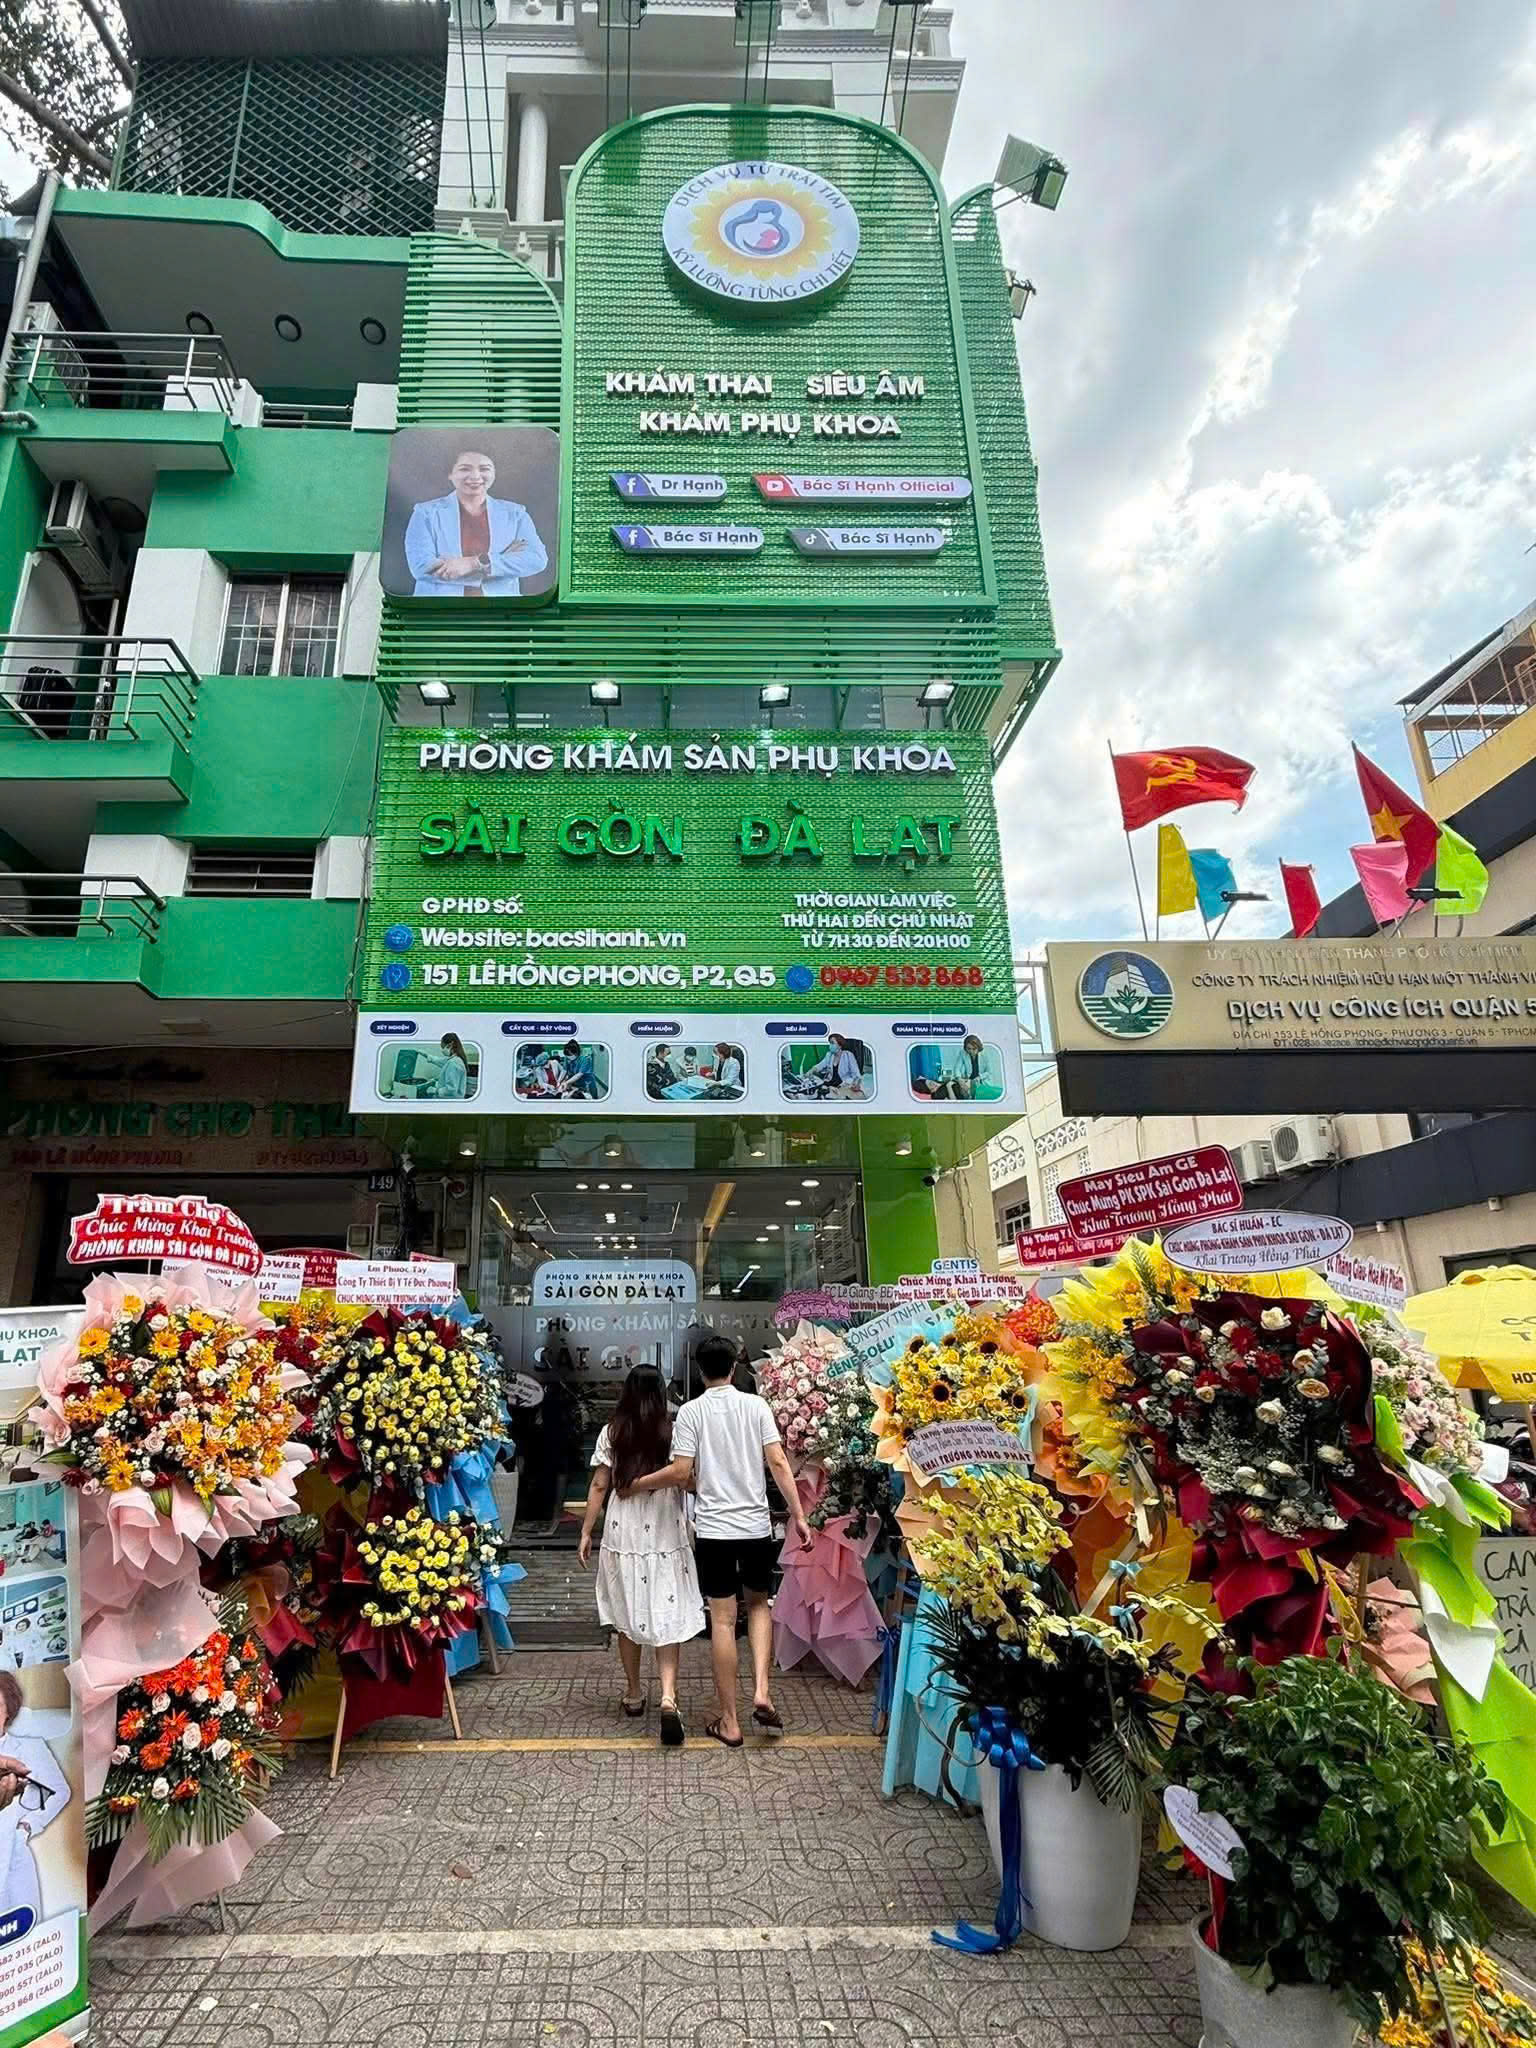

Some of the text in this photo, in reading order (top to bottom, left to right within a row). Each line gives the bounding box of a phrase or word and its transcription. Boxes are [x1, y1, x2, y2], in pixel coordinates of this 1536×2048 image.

[675, 175, 714, 208] DỊCH
[819, 186, 847, 209] TIM
[799, 274, 829, 293] CHI
[825, 250, 854, 279] TIẾT
[606, 365, 926, 396] KHÁM THAI SIÊU ÂM
[639, 405, 902, 443] KHÁM PHỤ KHOA
[661, 478, 724, 496] Dr Hạnh
[803, 477, 956, 496] Bác Sĩ Hạnh Official
[663, 528, 760, 548] Bác Sĩ Hạnh
[841, 530, 936, 549] Bác Sĩ Hạnh
[419, 731, 957, 778] PHÒNG KHÁM SẢN PHỤ KHOA
[418, 798, 962, 873] SÀI GÒN ĐÀ LẠT
[422, 893, 524, 915] GPHĐ số:
[782, 908, 975, 930] THỨ HAI ĐẾN CHỦ NHẬT
[526, 927, 686, 948] bacsihanh.vn
[801, 931, 824, 948] TỪ
[909, 934, 971, 948] 20H00
[421, 964, 458, 986] 151
[819, 966, 984, 987] 0967 533 868
[1191, 969, 1520, 988] CÔNG TY TRÁCH NHIỆM HỮU HẠN MỘT THÀNH
[1228, 994, 1536, 1024] DỊCH VỤ CÔNG ÍCH QUẬN 5
[1274, 1030, 1293, 1039] 153
[1310, 1027, 1342, 1039] HỒNG
[1344, 1028, 1383, 1038] PHONG
[1442, 1029, 1448, 1037] 3
[1488, 1028, 1495, 1037] 5
[164, 1100, 254, 1140] CHO
[1175, 1155, 1199, 1171] GE
[369, 1175, 395, 1191] 149
[1118, 1187, 1136, 1206] PK
[1133, 1182, 1158, 1203] SPK
[1270, 1215, 1283, 1228] EC
[86, 1215, 260, 1254] Chúc Mừng Khai Trương
[76, 1233, 250, 1270] PHÒNG KHÁM SÀI GÒN ĐÀ LẠT
[933, 1259, 978, 1271] GENTIS
[585, 1271, 613, 1281] KHÁM
[616, 1271, 635, 1281] SẢN
[638, 1273, 656, 1282] PHỤ
[659, 1273, 685, 1281] KHOA
[899, 1274, 1017, 1288] Chúc Mừng Khai Trương
[544, 1281, 686, 1302] SÀI GÒN ĐÀ LẠT
[996, 1286, 1024, 1297] CN HCM
[535, 1312, 607, 1333] PHÒNG
[611, 1311, 669, 1331] KHÁM
[891, 1302, 928, 1325] TNHH
[18, 1327, 58, 1340] KHOA
[921, 1460, 939, 1473] KHAI
[939, 1450, 973, 1465] TRƯƠNG
[973, 1446, 1001, 1460] HỒNG
[1494, 1586, 1536, 1621] TRÀ
[15, 1930, 62, 1960] 315 (ZALO)
[17, 1944, 64, 1974] 035 (ZALO)
[17, 1961, 63, 1991] 557 (ZALO)
[17, 1976, 64, 2008] 868 (ZALO)
